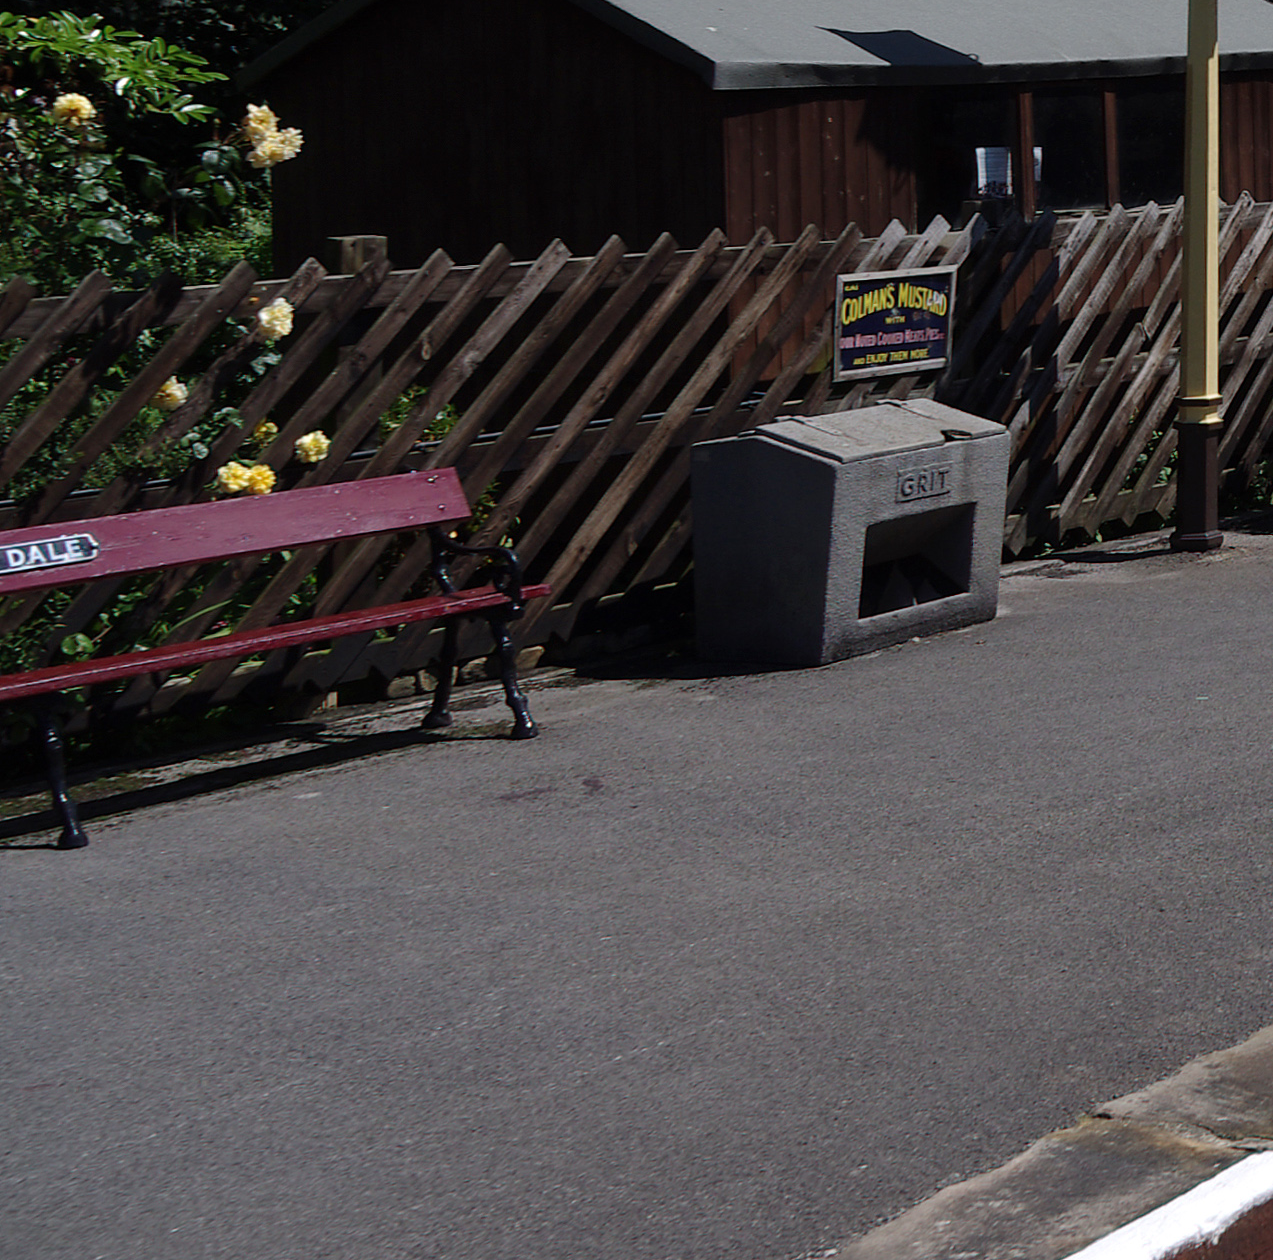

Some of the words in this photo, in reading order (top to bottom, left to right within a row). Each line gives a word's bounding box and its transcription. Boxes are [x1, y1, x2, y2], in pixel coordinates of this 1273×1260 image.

[898, 282, 947, 316] MUSTARD
[885, 316, 905, 324] WITH
[866, 353, 888, 364] ENJOY
[889, 350, 909, 362] THEM
[901, 468, 951, 497] GRIT
[5, 539, 84, 568] DALE
